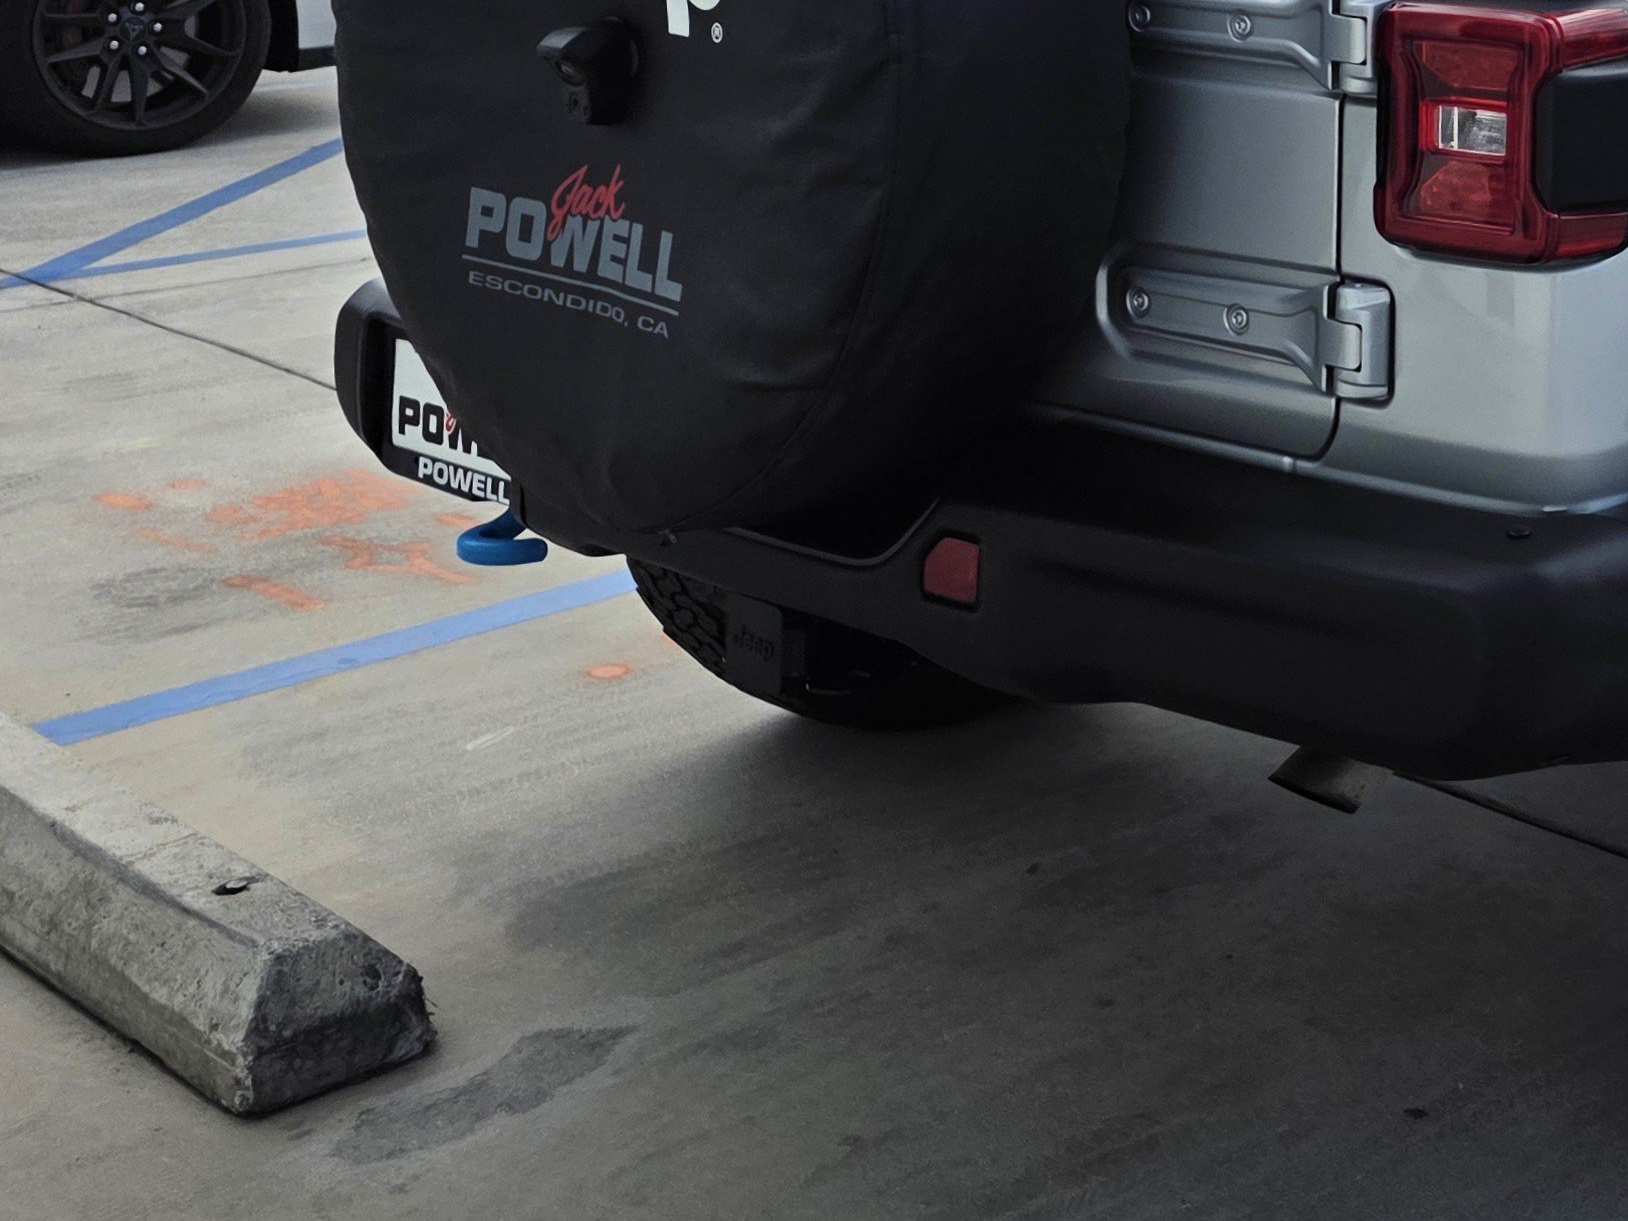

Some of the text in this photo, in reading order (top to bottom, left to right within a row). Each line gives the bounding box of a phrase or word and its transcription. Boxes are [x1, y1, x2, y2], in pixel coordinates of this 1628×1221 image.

[547, 164, 625, 241] Jack
[465, 186, 683, 302] POWELL
[468, 270, 669, 340] ESCONDIDO, CA
[418, 456, 511, 506] POWELL
